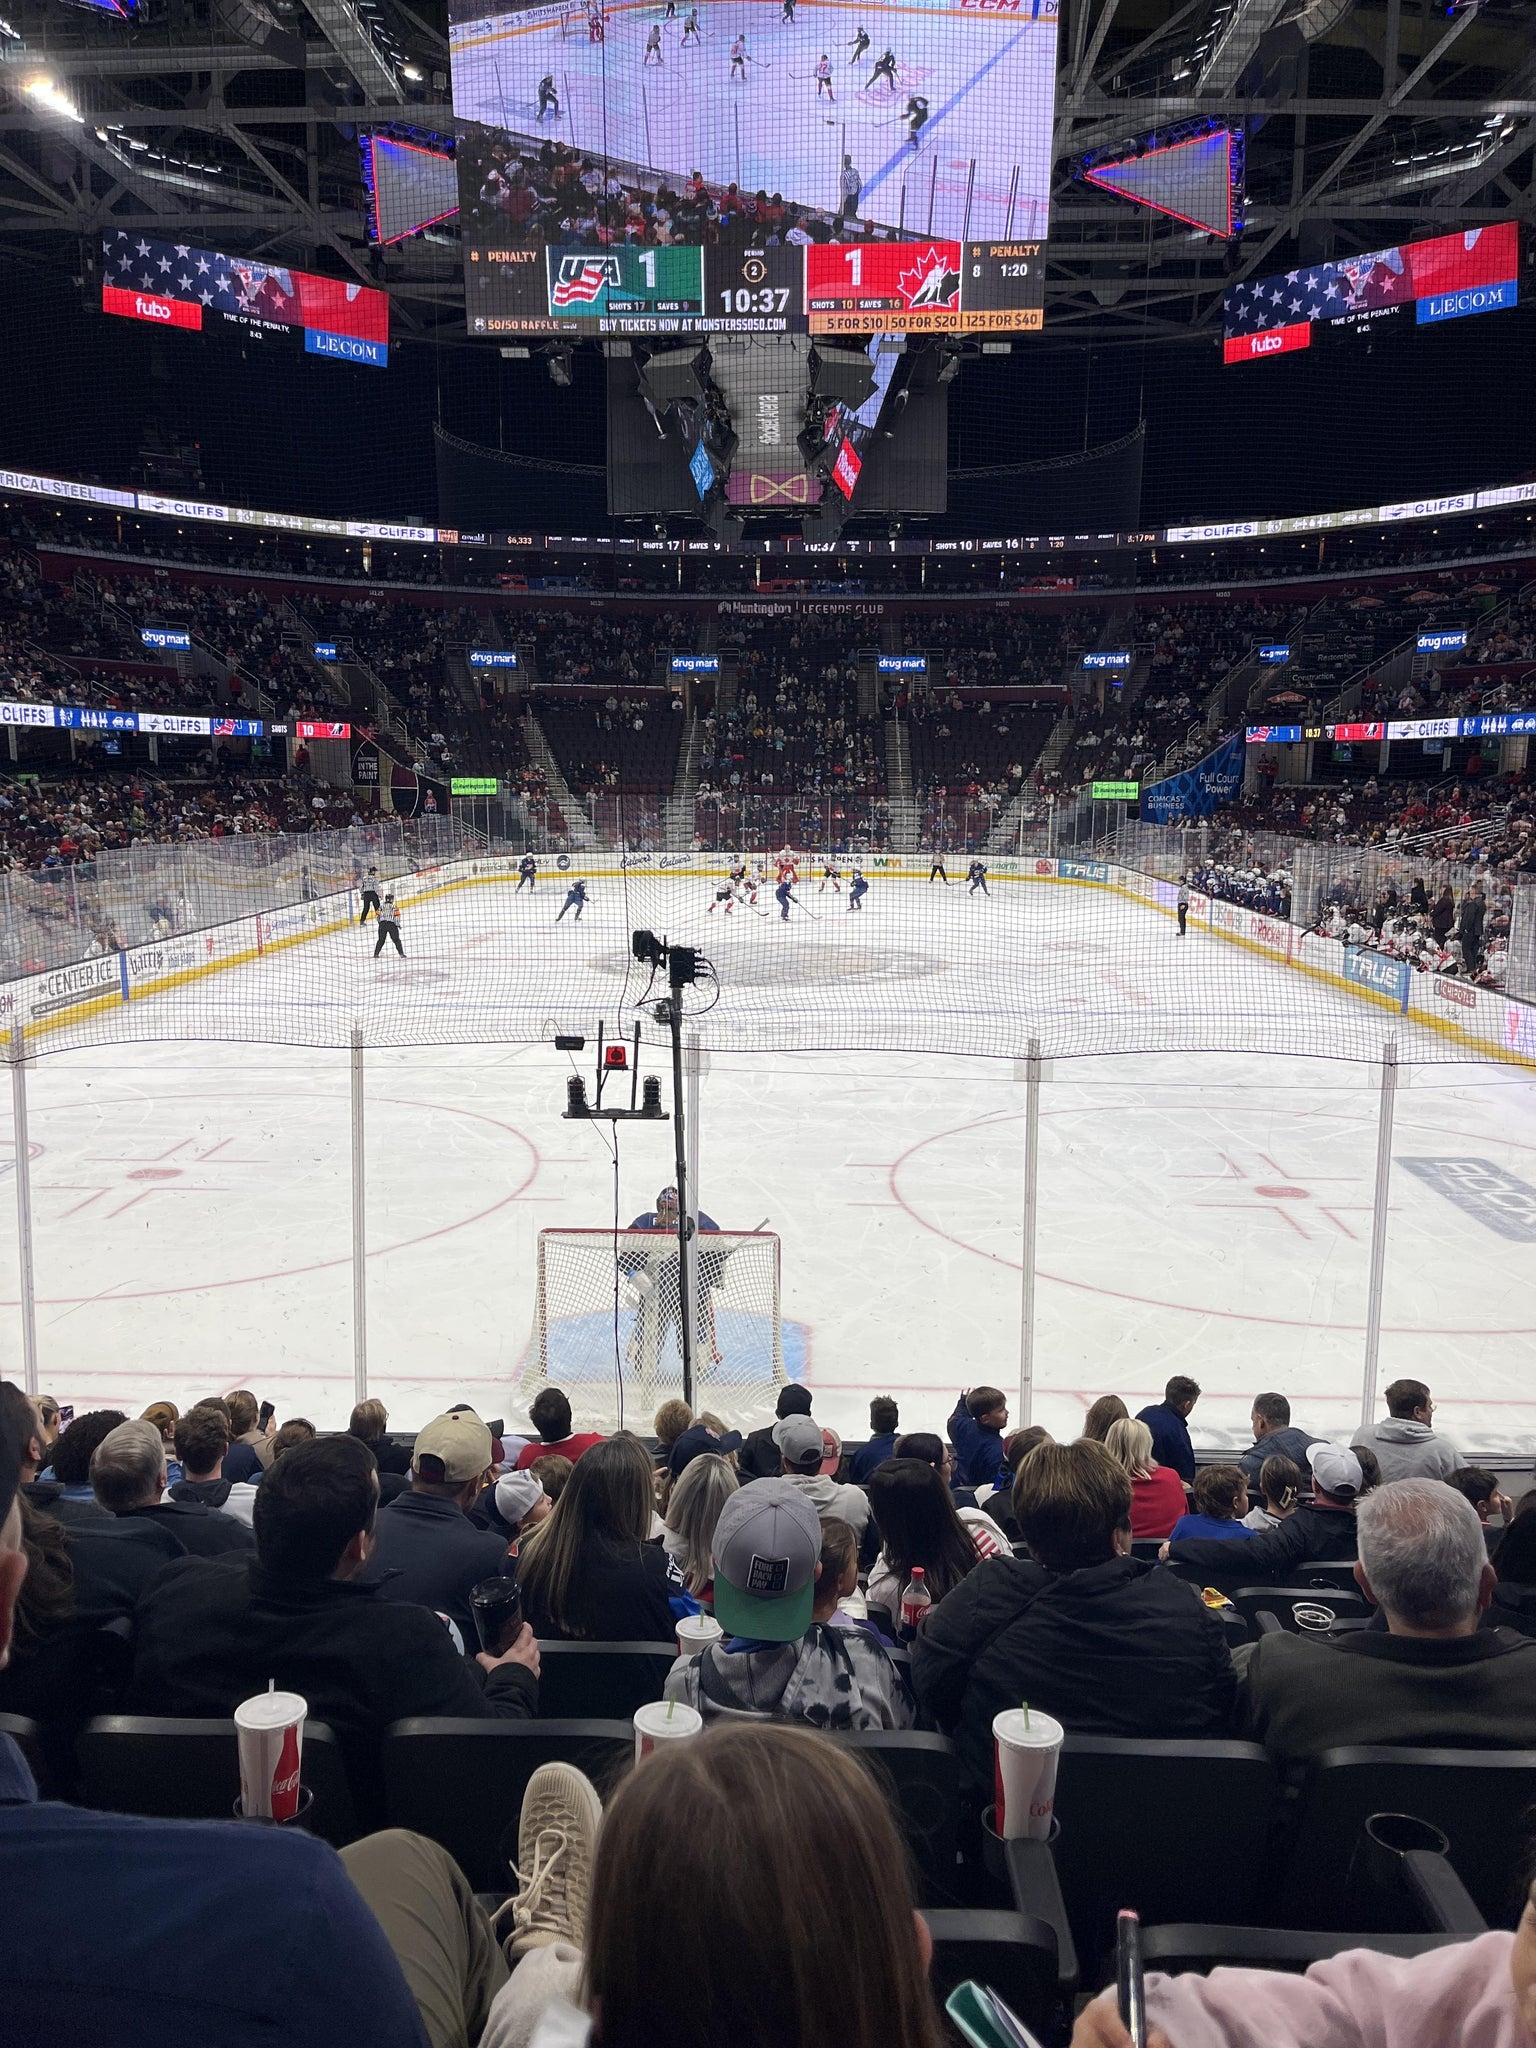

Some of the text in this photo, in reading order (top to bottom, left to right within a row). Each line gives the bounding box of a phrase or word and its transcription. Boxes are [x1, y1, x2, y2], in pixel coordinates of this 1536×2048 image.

[487, 251, 537, 263] PENALTY
[990, 245, 1040, 257] PENALTY
[638, 250, 655, 288] 1
[751, 266, 758, 276] 2
[845, 248, 861, 286] 1
[972, 264, 1028, 277] 8 1:20
[553, 254, 621, 307] USA
[609, 301, 646, 311] SHOTS 17
[657, 302, 679, 311] SAVES
[720, 288, 790, 313] 10:37
[811, 301, 853, 310] SHOTS 10
[859, 299, 900, 309] SAVES 16
[135, 297, 171, 319] fubo
[488, 319, 518, 331] 50/50
[520, 320, 559, 331] RAFFLE
[599, 319, 616, 332] BUY
[620, 319, 656, 332] TICKETS
[659, 318, 679, 331] NOW
[682, 318, 693, 331] AT
[827, 317, 883, 329] 5 FOR $10
[891, 316, 957, 328] 50 FOR $20
[966, 313, 1038, 327] 125 FOR $40
[1251, 335, 1282, 354] fubo
[0, 473, 96, 499] TRICAL STEEL
[174, 503, 224, 518] CLIFFS
[1415, 498, 1464, 514] CLIFFS
[379, 527, 425, 539] CLIFFS
[1203, 525, 1252, 538] CLIFFS
[642, 541, 680, 551] SHOTS 17
[689, 542, 709, 550] SAVES
[763, 540, 770, 552] 1
[888, 540, 896, 552] 1
[960, 540, 973, 551] 10
[982, 538, 1018, 549] SAVES 16
[733, 601, 884, 617] Huntington LEGENDS CLUB
[142, 631, 190, 646] drug mart
[1418, 636, 1441, 650] drug
[471, 652, 517, 665] drug mart
[672, 657, 719, 669] drug mart
[879, 657, 926, 670] drug mart
[1083, 653, 1130, 667] drug mart
[3, 706, 46, 723] CLIFFS
[163, 719, 201, 732] CLIFFS
[248, 722, 258, 735] 17
[271, 724, 288, 734] SHOTS
[302, 724, 314, 736] 10
[1418, 722, 1449, 736] CLIFFS
[1289, 728, 1294, 739] 1
[366, 762, 378, 771] THE
[358, 771, 378, 780] PAINT
[1200, 773, 1239, 784] Full Court
[1205, 784, 1233, 795] Power
[1065, 862, 1105, 879] TRUE
[48, 959, 113, 996] CENTER ICE
[1349, 953, 1399, 989] TRUE
[1441, 982, 1475, 1006] CHIPOTLE
